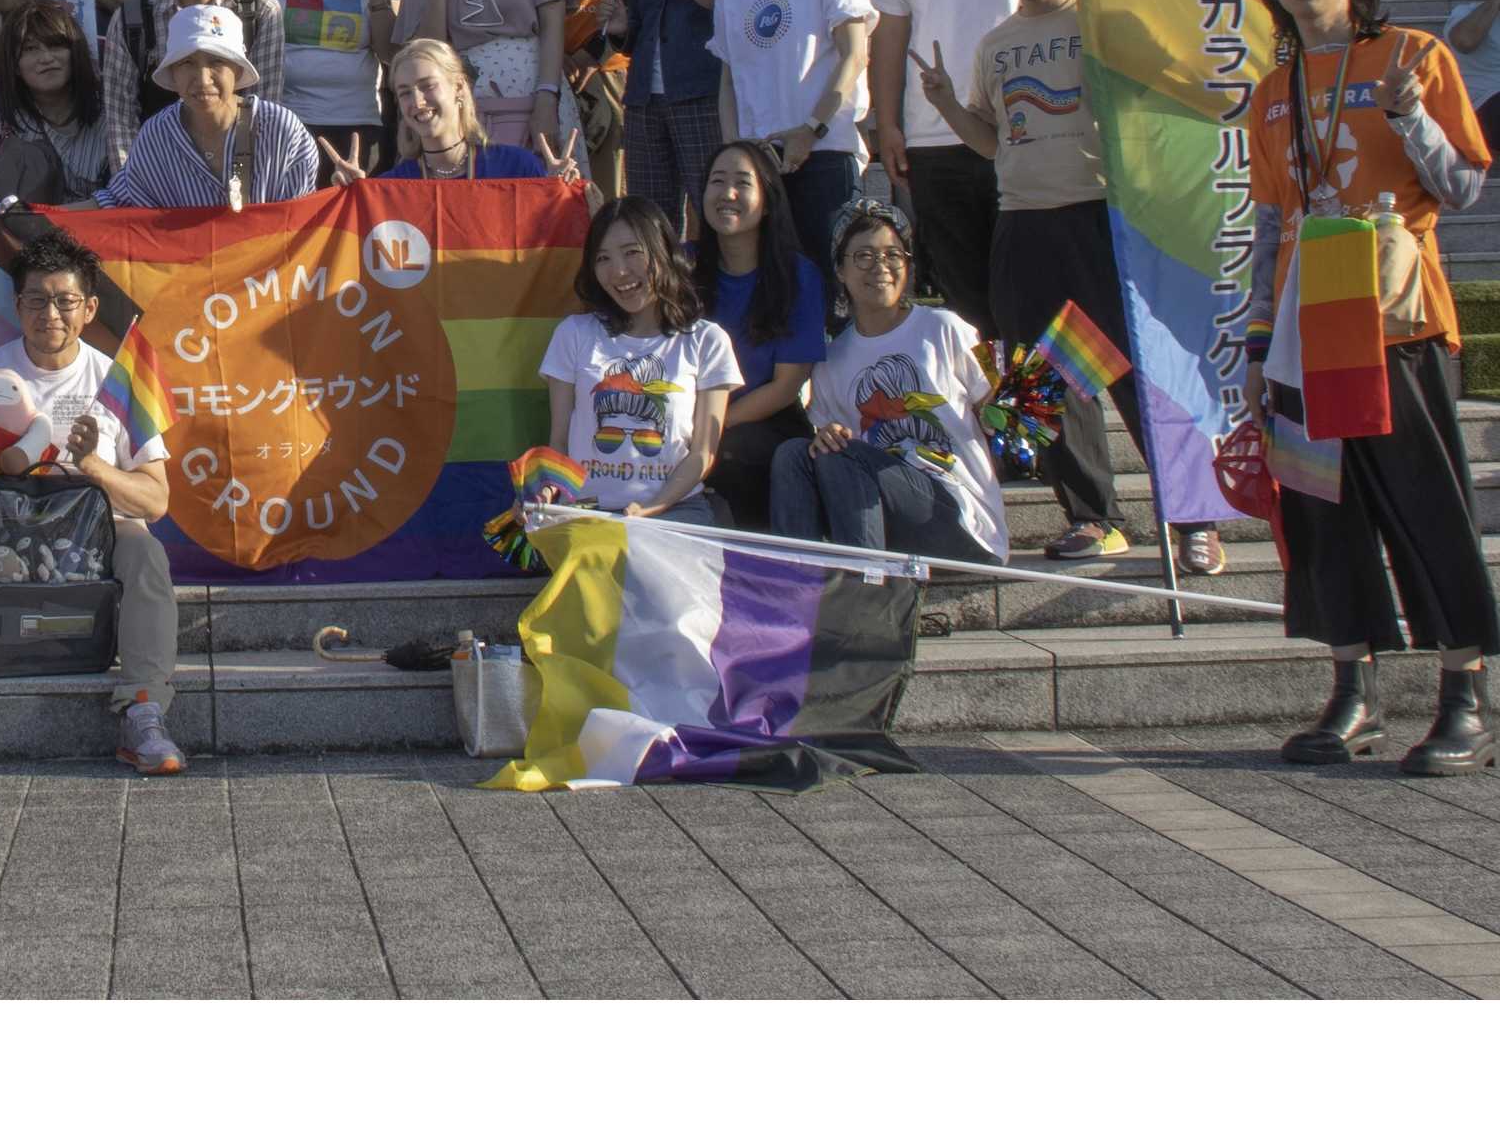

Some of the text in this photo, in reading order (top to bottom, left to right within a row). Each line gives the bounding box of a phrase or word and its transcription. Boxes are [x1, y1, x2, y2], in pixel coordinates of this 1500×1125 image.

[760, 11, 779, 28] P&G
[995, 35, 1083, 74] STAFF
[372, 238, 426, 272] NL
[174, 264, 405, 364] COMMON
[171, 373, 420, 417] コモングラウンド
[255, 438, 334, 460] オランダ
[181, 436, 407, 536] GROUND
